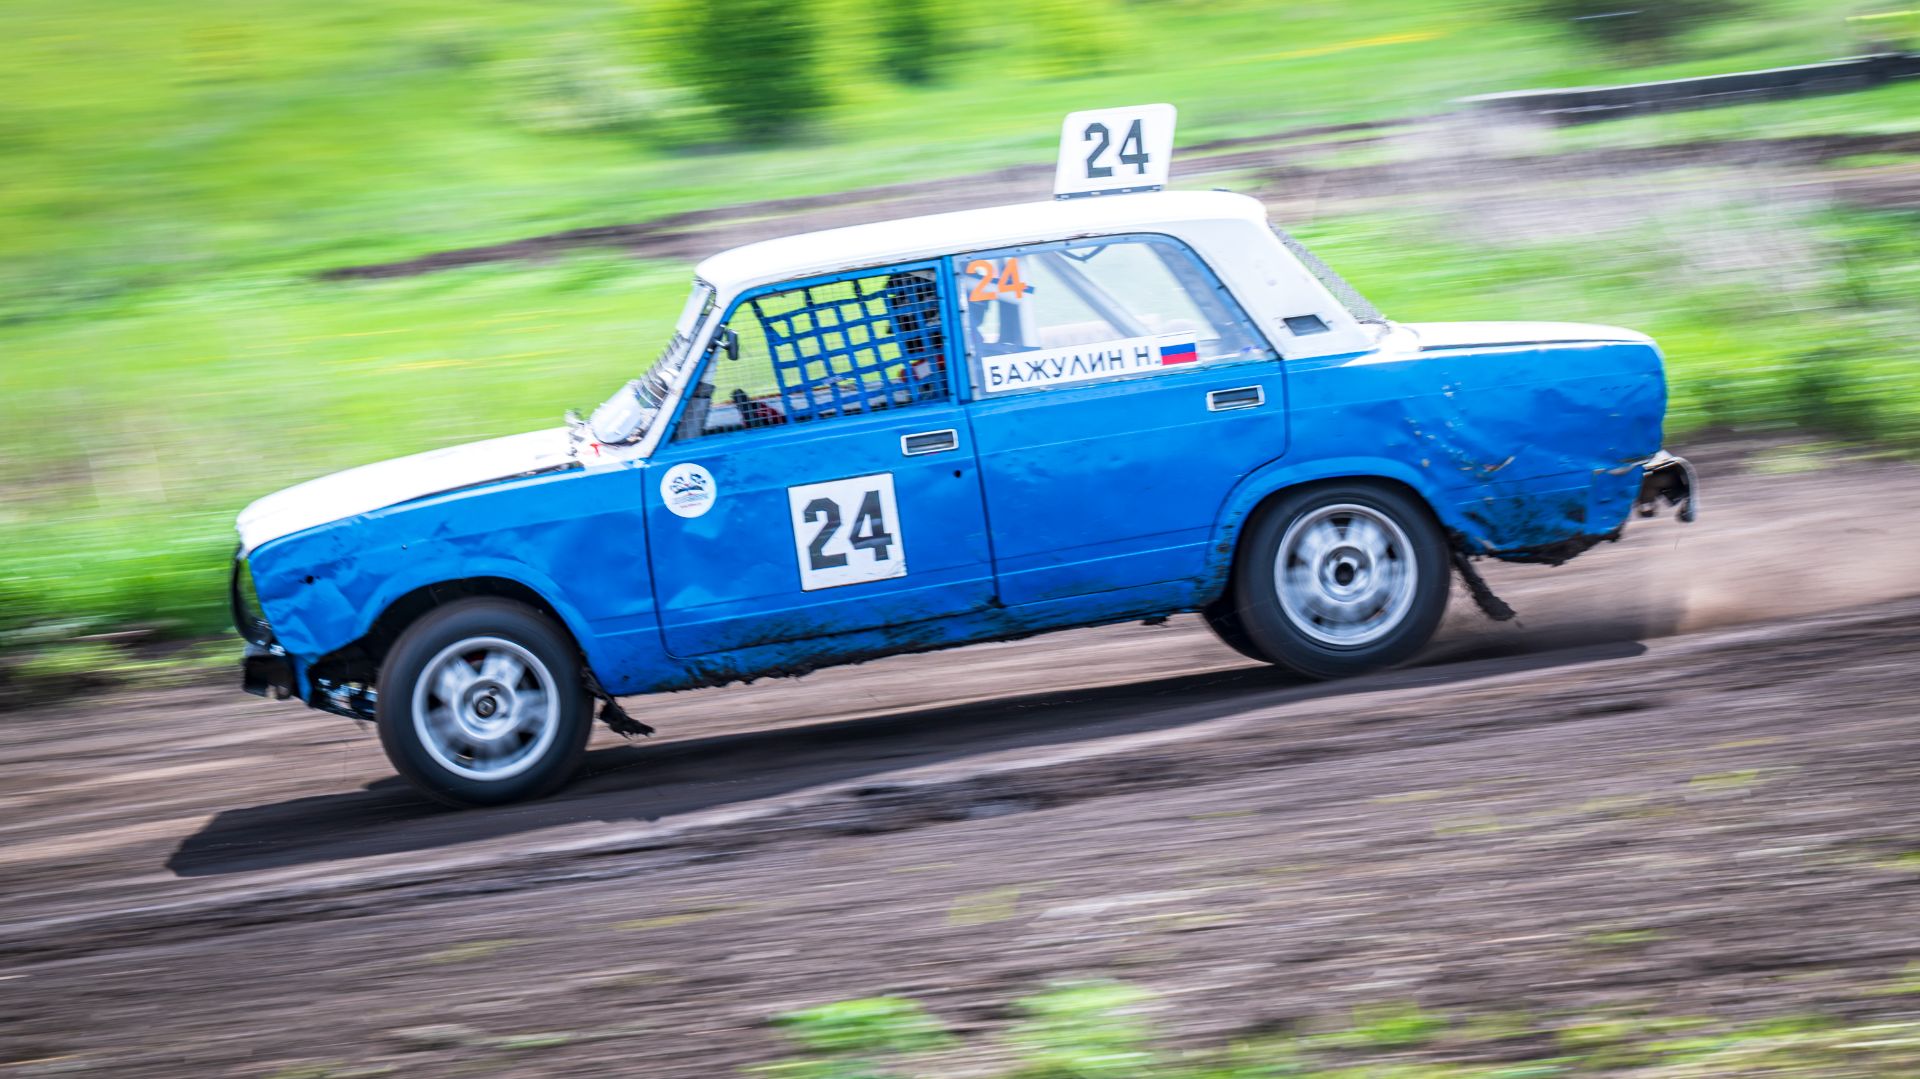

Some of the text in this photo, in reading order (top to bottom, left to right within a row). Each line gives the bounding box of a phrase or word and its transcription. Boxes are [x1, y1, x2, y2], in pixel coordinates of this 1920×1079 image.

[1085, 119, 1149, 178] 24
[966, 257, 1027, 301] 24
[989, 345, 1161, 386] БАЖУЛИН Н.
[803, 490, 893, 571] 24
